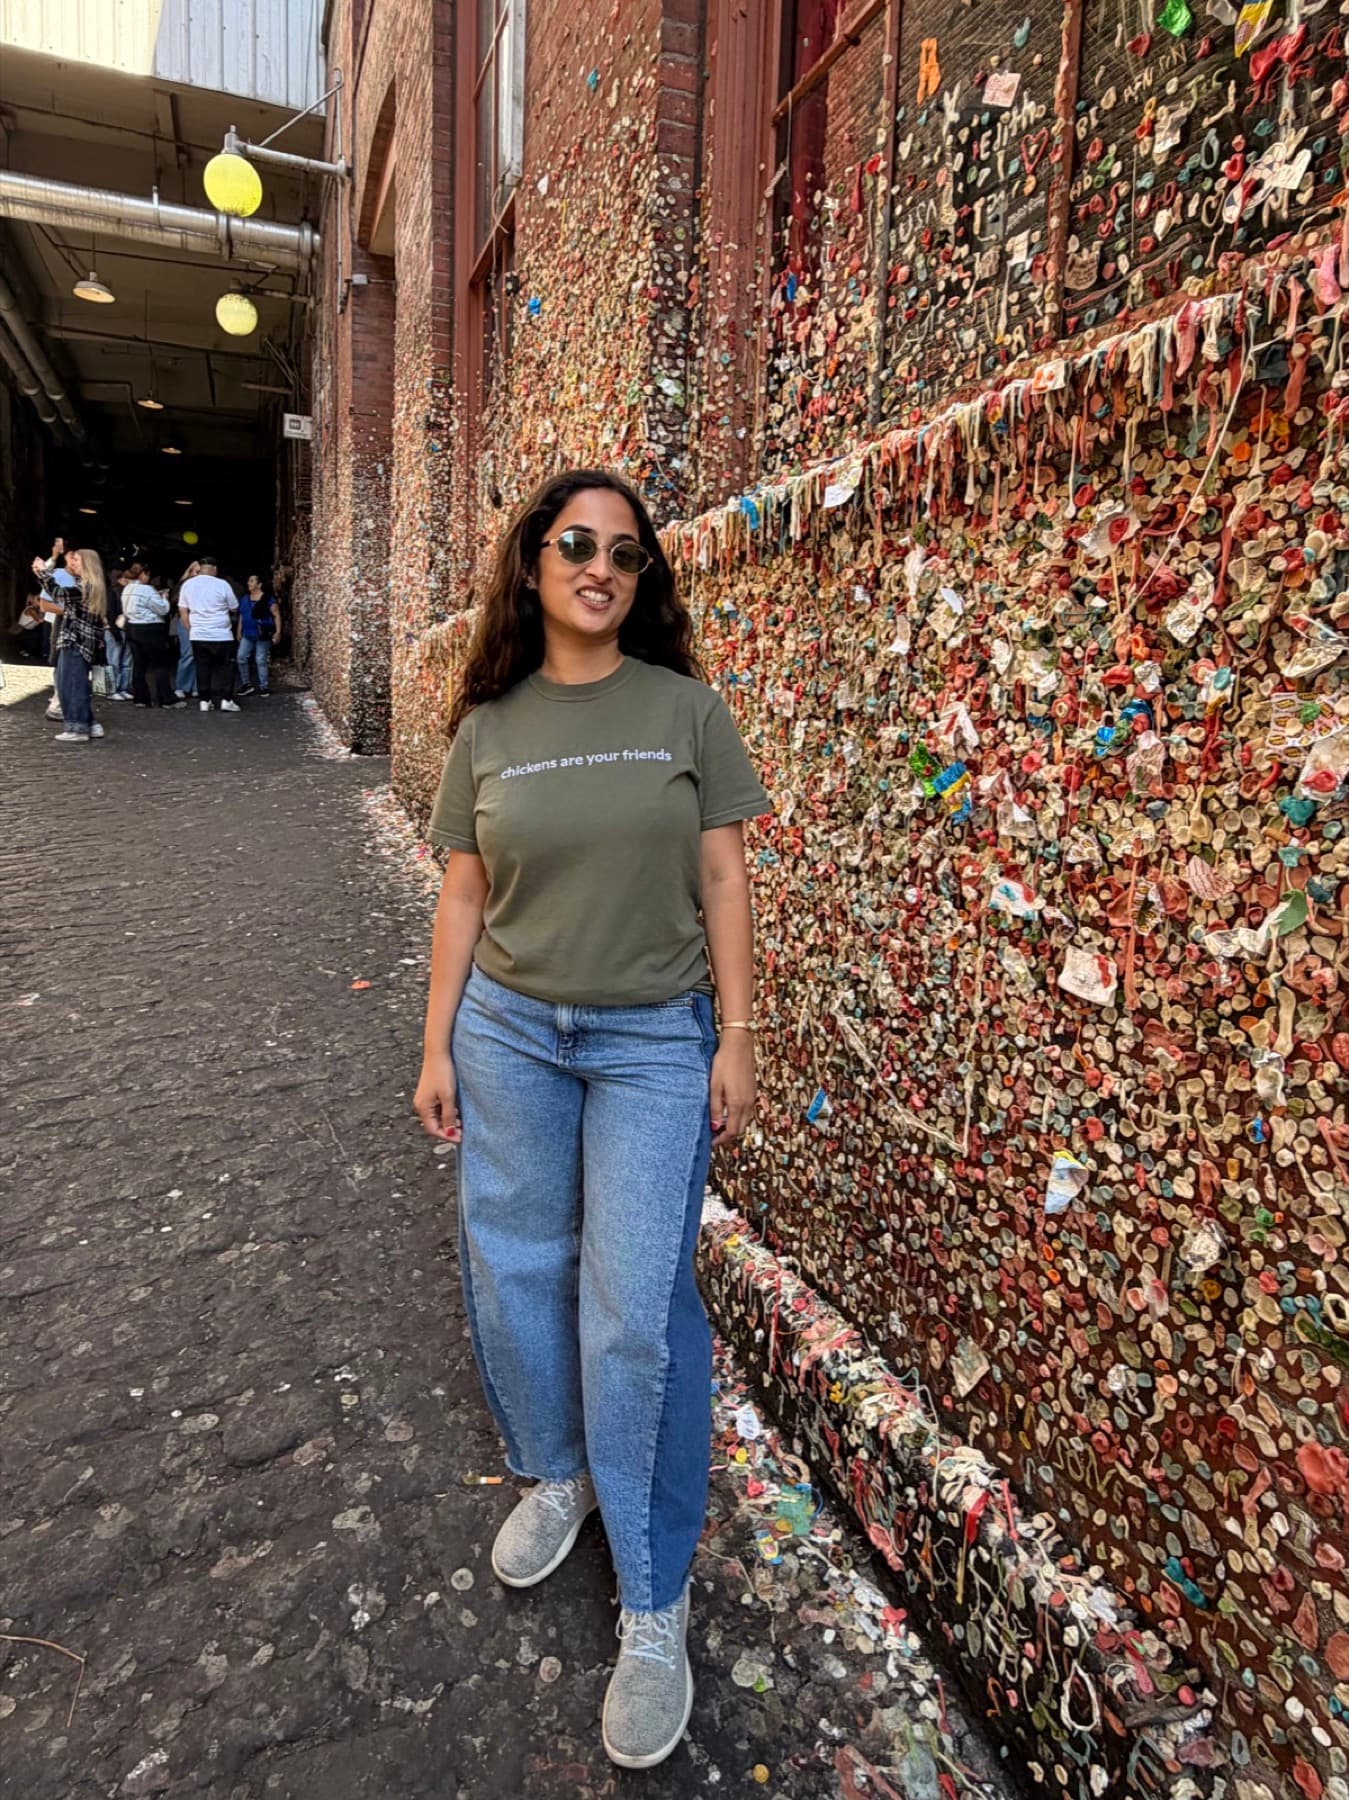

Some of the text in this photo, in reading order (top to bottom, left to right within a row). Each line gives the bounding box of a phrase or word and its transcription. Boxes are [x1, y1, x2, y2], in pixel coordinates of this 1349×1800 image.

[500, 748, 672, 779] chickens are your friends
